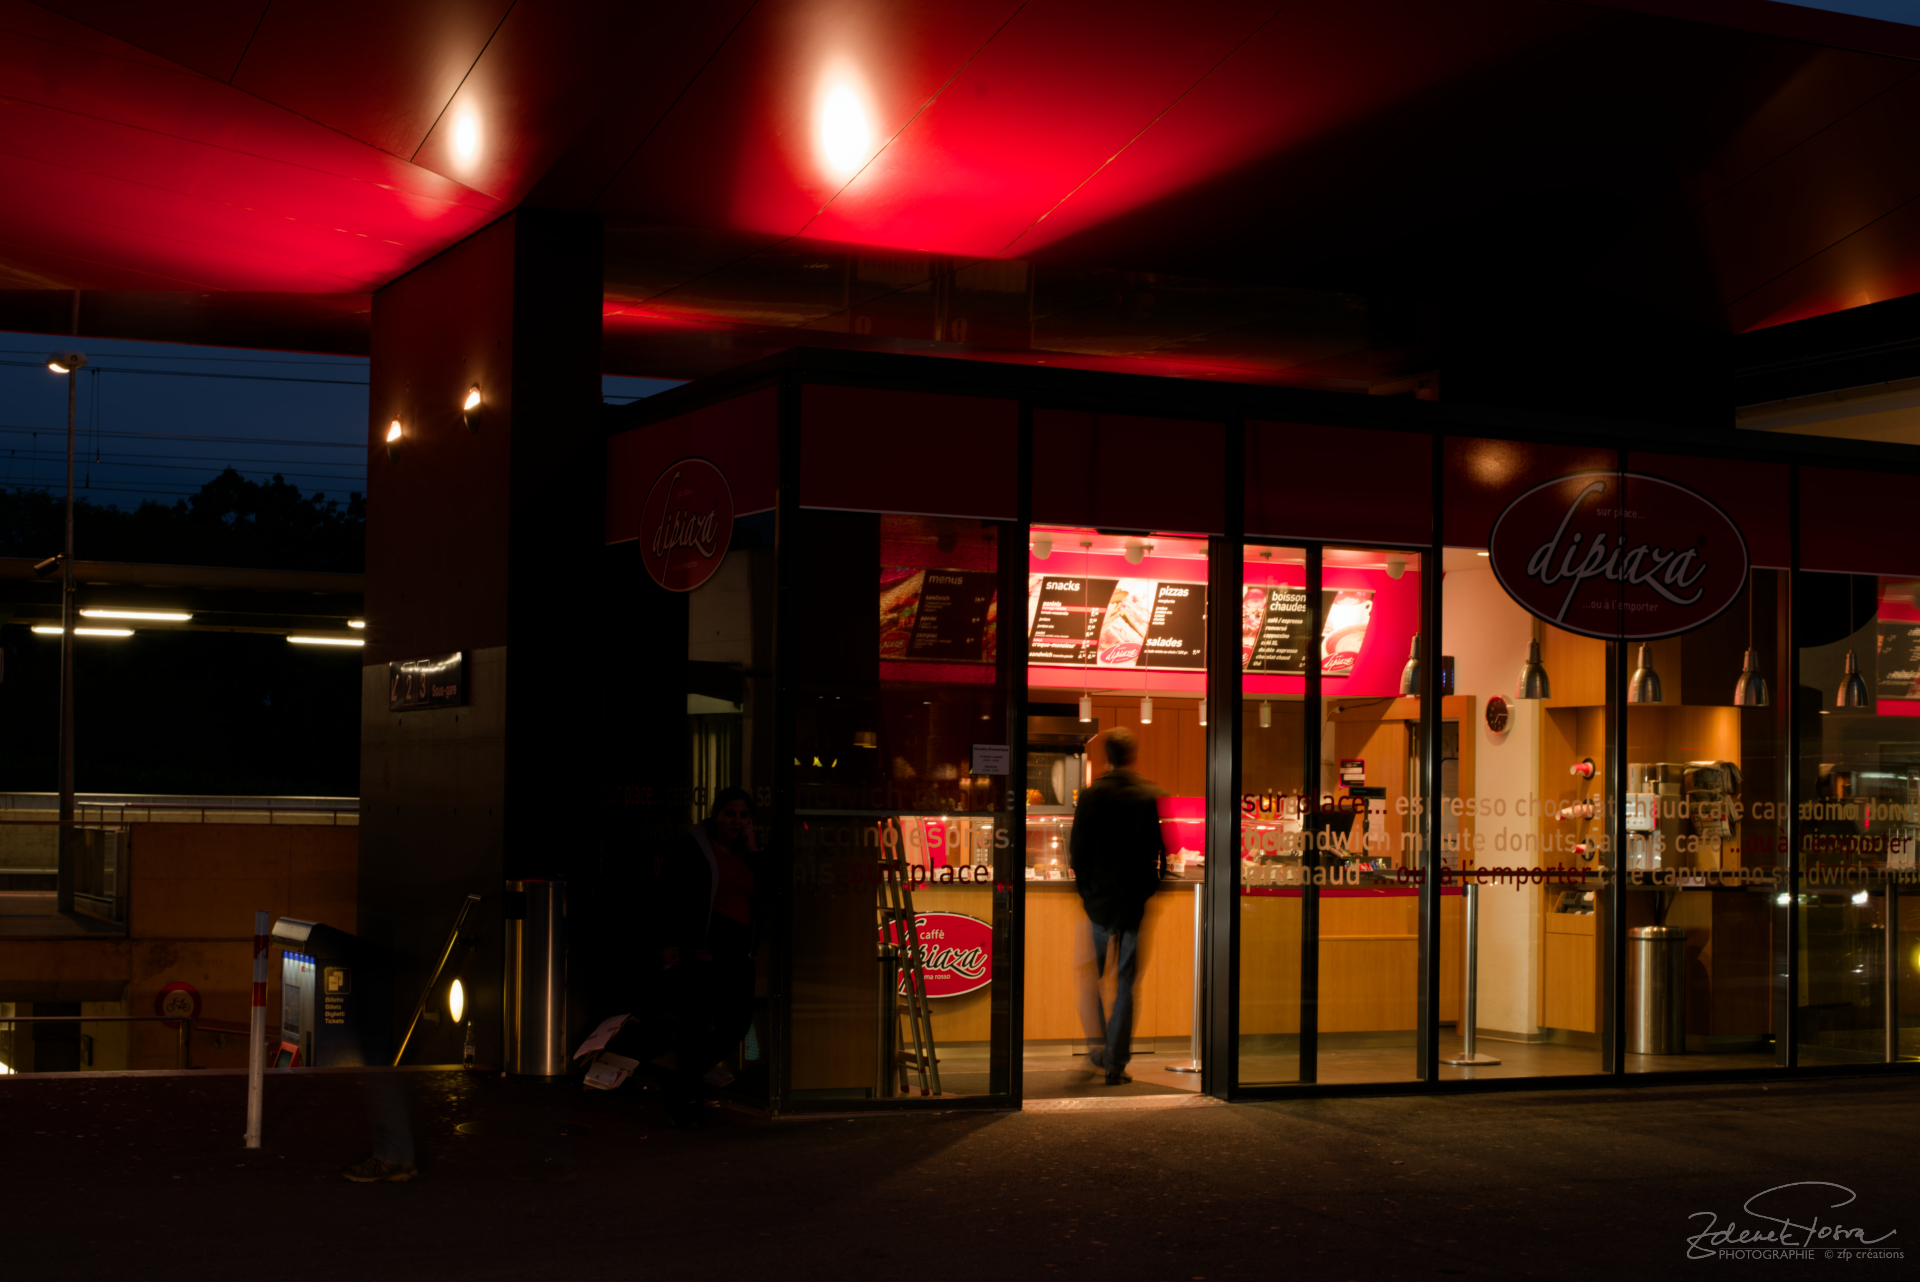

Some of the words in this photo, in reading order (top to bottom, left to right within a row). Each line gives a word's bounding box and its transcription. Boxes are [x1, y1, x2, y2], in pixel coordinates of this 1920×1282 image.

[1596, 508, 1612, 517] sur
[1613, 507, 1646, 520] place...
[1526, 481, 1708, 622] dipiaza
[928, 575, 964, 585] menus
[1045, 580, 1081, 591] snacks
[1158, 586, 1190, 598] pizzas
[1269, 601, 1306, 612] chaudes
[1604, 599, 1610, 610] à
[1146, 637, 1183, 648] salades
[1243, 793, 1288, 814] sur
[1296, 787, 1388, 820] place...
[1395, 795, 1507, 818] esresso
[1515, 792, 1616, 818] chocolat
[910, 826, 1015, 856] espres
[1400, 825, 1486, 852] miute
[1495, 827, 1576, 853] donuts
[1730, 834, 1772, 854] ...ou
[1778, 827, 1789, 854] à
[849, 863, 900, 885] sur
[912, 857, 1015, 892] place...
[1373, 865, 1427, 885] ...ou
[1440, 858, 1453, 885] à
[1462, 860, 1592, 892] l'emporter
[1597, 858, 1644, 886] caé
[919, 929, 945, 940] caffè
